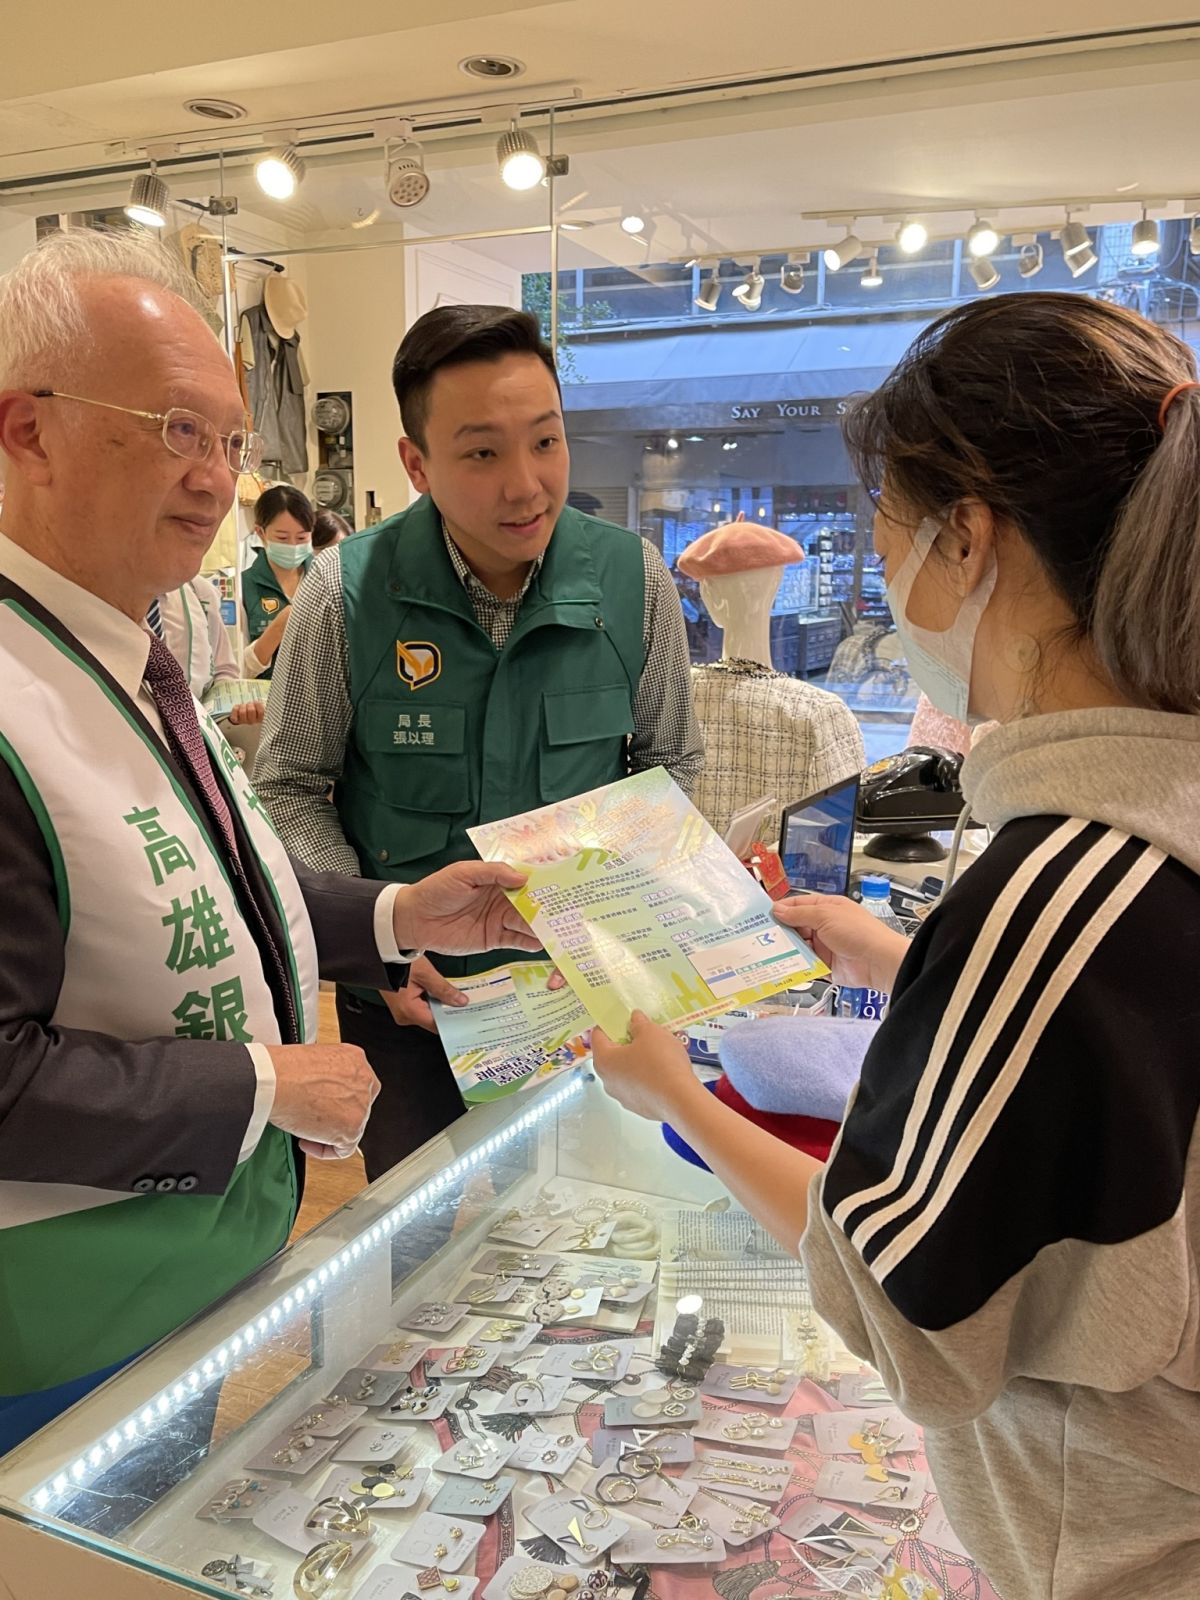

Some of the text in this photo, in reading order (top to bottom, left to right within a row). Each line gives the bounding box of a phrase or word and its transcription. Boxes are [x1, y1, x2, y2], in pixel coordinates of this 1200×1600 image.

[731, 406, 761, 419] SAY
[776, 403, 821, 417] YOUR
[398, 714, 432, 728] 局長
[393, 731, 435, 745] 張以理
[122, 806, 254, 1043] 高雄銀
